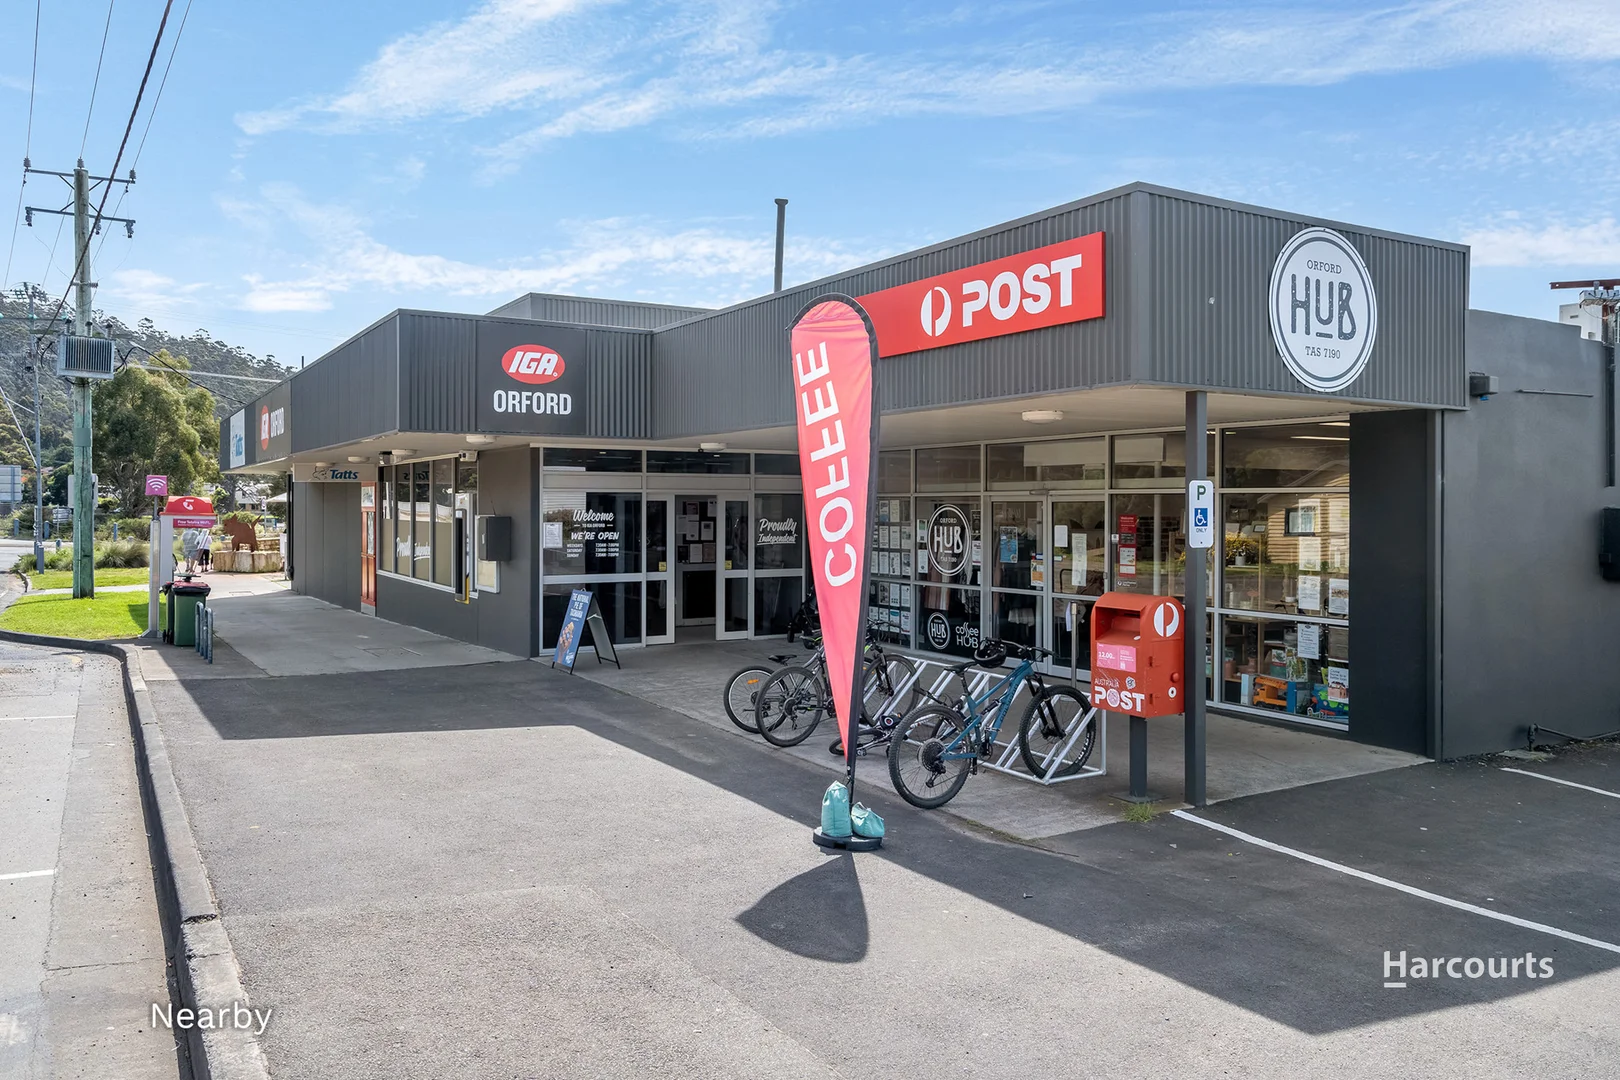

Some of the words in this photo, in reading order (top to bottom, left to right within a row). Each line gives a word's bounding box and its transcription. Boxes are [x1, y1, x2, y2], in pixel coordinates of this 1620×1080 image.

[1306, 259, 1342, 275] ORFORD
[962, 253, 1082, 328] POST
[1290, 273, 1357, 340] HUB
[1305, 345, 1322, 357] TAS
[1324, 348, 1341, 359] 7190
[508, 351, 558, 376] IGA
[493, 389, 572, 415] ORFORD
[329, 469, 360, 480] Tatts
[1197, 485, 1207, 501] P
[572, 508, 614, 522] Welcome
[759, 518, 798, 534] Proudly
[570, 530, 596, 540] WE'RE
[597, 531, 620, 540] OPEN
[757, 533, 798, 545] Independent
[934, 525, 963, 554] HUB
[930, 622, 948, 639] HUB
[955, 621, 980, 638] coffee
[956, 635, 980, 649] HUB
[1094, 677, 1120, 688] AUSTRALIA
[1094, 685, 1145, 713] POST
